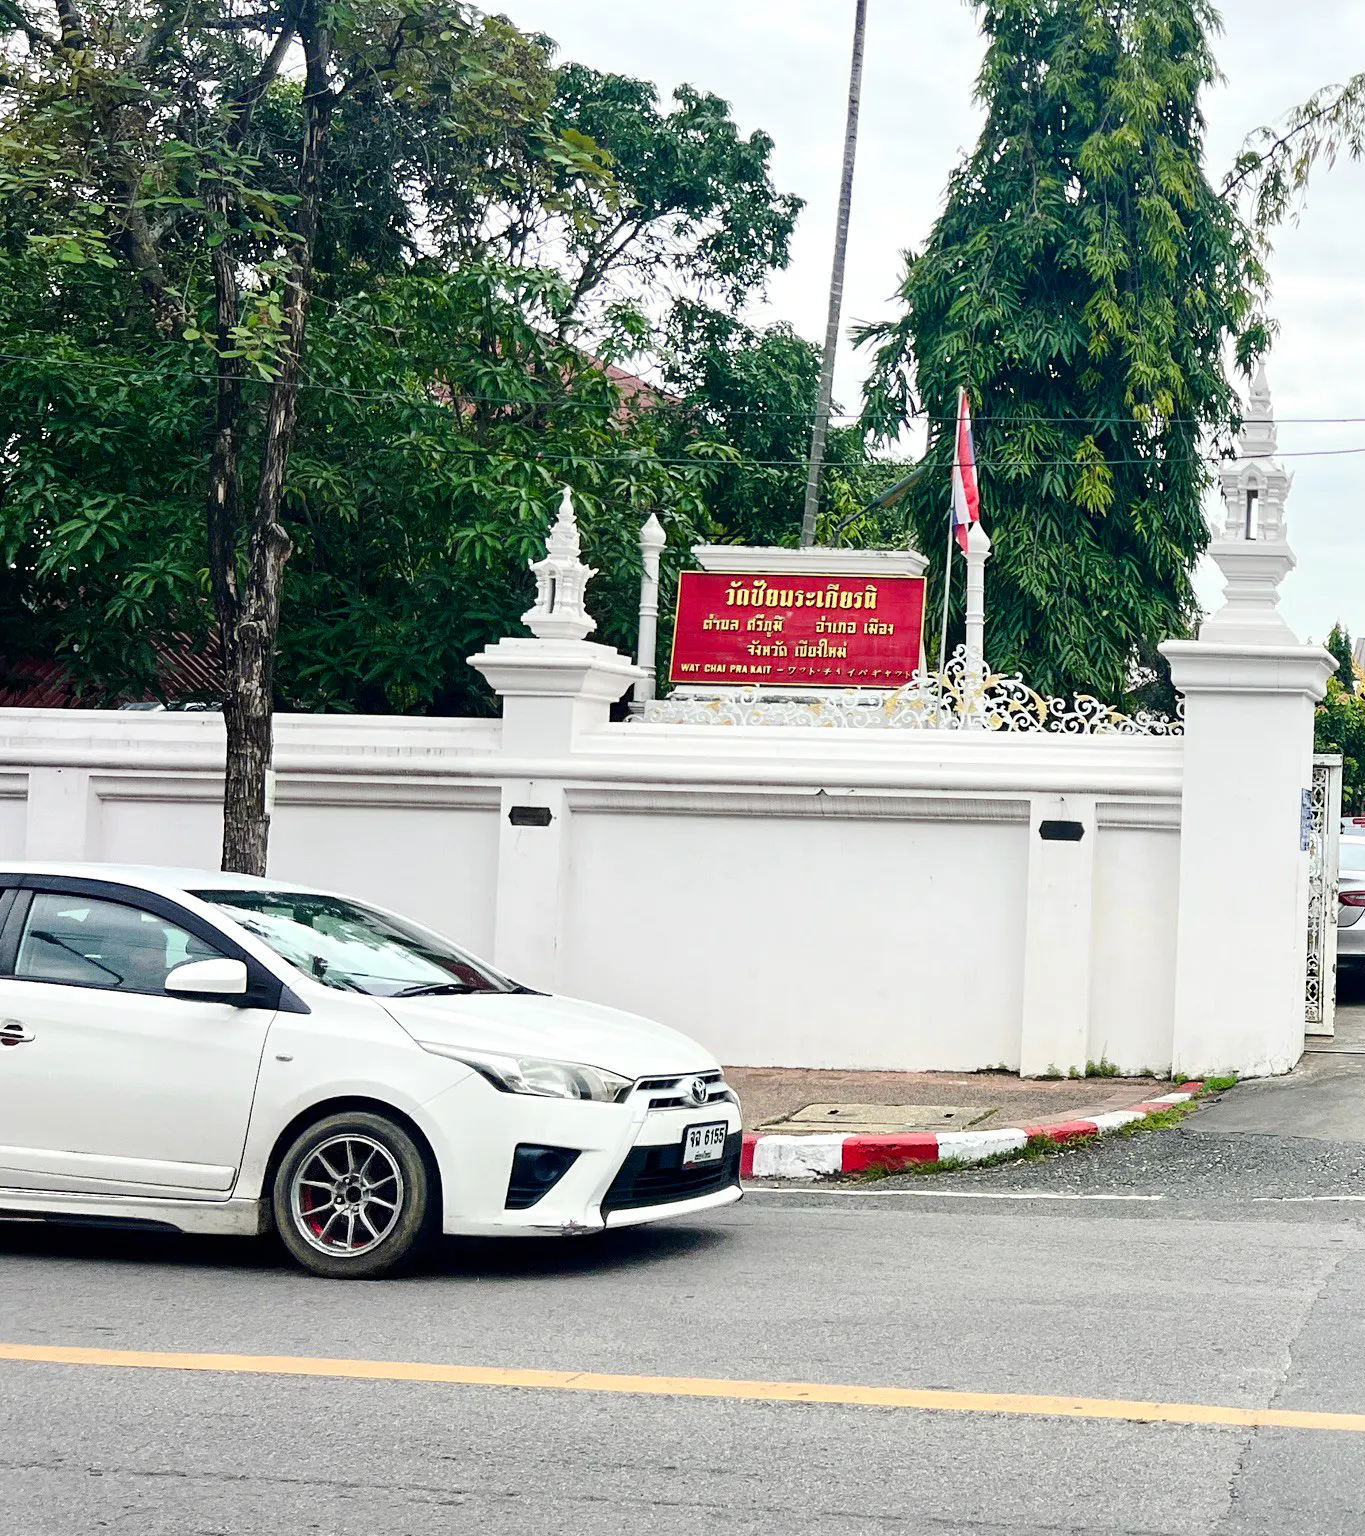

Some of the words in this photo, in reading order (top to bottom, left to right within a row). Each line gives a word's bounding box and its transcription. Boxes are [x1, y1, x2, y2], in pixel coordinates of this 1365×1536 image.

[725, 580, 878, 609] วัดชัยพระเกียรติ
[703, 613, 740, 631] ตำบล
[746, 613, 785, 638] ศรีภูมิ
[815, 616, 857, 634] อำเภอ
[863, 618, 894, 635] เมือง
[747, 640, 788, 657] จังหวัด
[795, 639, 847, 658] เชียงใหม่
[681, 664, 700, 672] WAT
[704, 664, 726, 673] CHAI
[729, 665, 748, 674] PRA
[750, 665, 772, 674] KAIT
[704, 1128, 724, 1145] 6155
